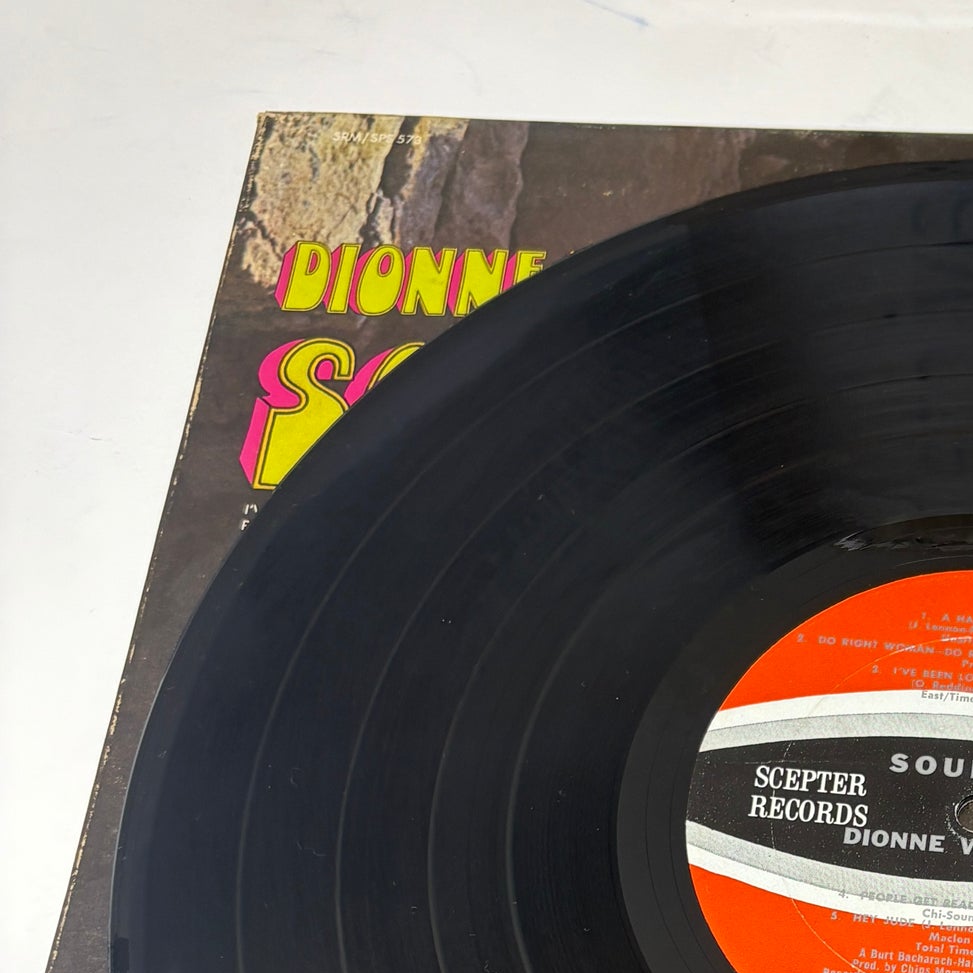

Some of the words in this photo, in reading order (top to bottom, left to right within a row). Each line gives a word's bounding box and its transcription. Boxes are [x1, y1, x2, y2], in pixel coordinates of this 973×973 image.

[396, 134, 422, 145] 573
[941, 613, 950, 622] A
[818, 635, 836, 645] DO
[841, 637, 877, 649] RIGHT
[893, 666, 916, 677] I'VE
[922, 669, 953, 680] BEEN
[754, 764, 867, 797] SCEPTER
[748, 794, 869, 827] RECORDS
[843, 826, 946, 855] DIONNE
[838, 890, 849, 900] 4.
[860, 891, 909, 904] PEOPLE
[914, 895, 938, 907] GET
[852, 913, 879, 924] HEY
[883, 915, 915, 928] JUDE
[858, 948, 867, 958] A
[870, 948, 895, 961] Burt
[915, 941, 945, 954] Total
[851, 958, 880, 972] Prod.
[884, 960, 897, 973] by
